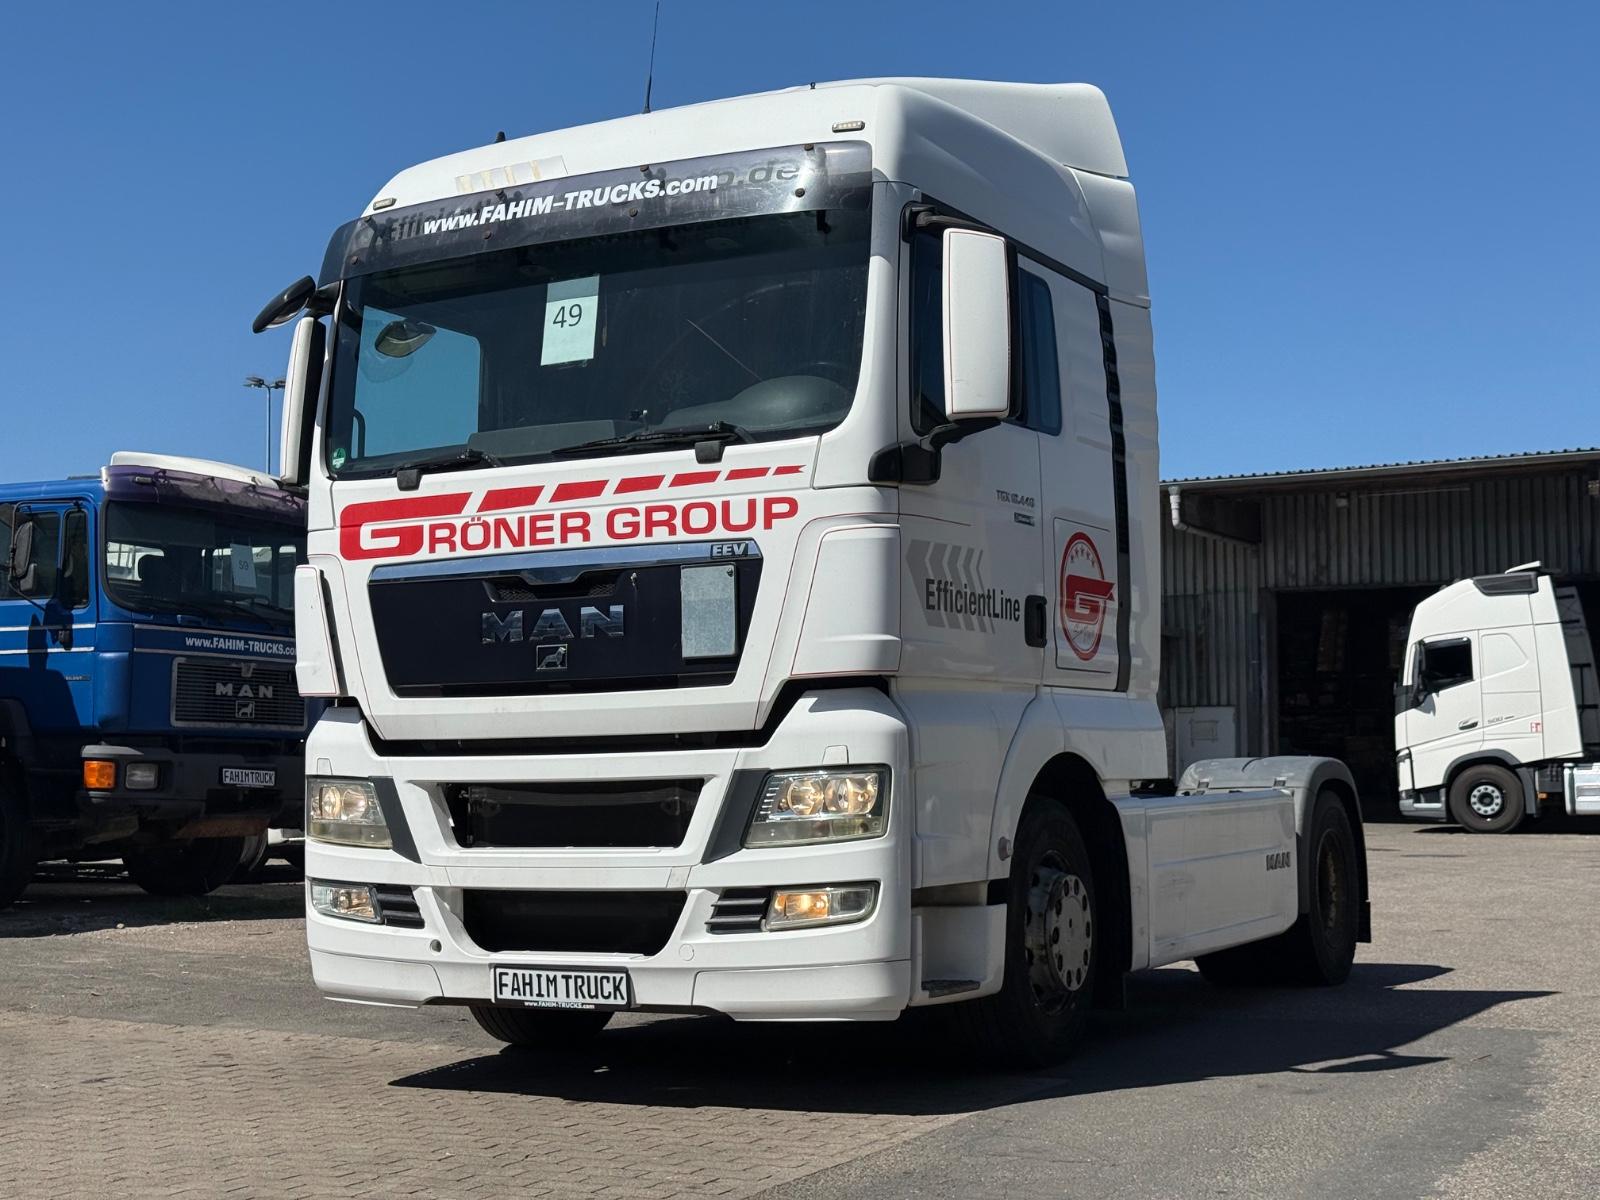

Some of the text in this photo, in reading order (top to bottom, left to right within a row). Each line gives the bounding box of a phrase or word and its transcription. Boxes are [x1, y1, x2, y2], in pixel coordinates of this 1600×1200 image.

[424, 174, 718, 235] www.FAHIM-TRUCKS.com
[553, 304, 582, 328] 49
[606, 497, 799, 541] GROUP
[712, 543, 747, 557] EEV
[925, 578, 1020, 622] EfficientLine
[482, 604, 624, 644] MAN
[185, 637, 297, 656] www.FAHIM-TRUCKS.co
[215, 682, 273, 698] MAN
